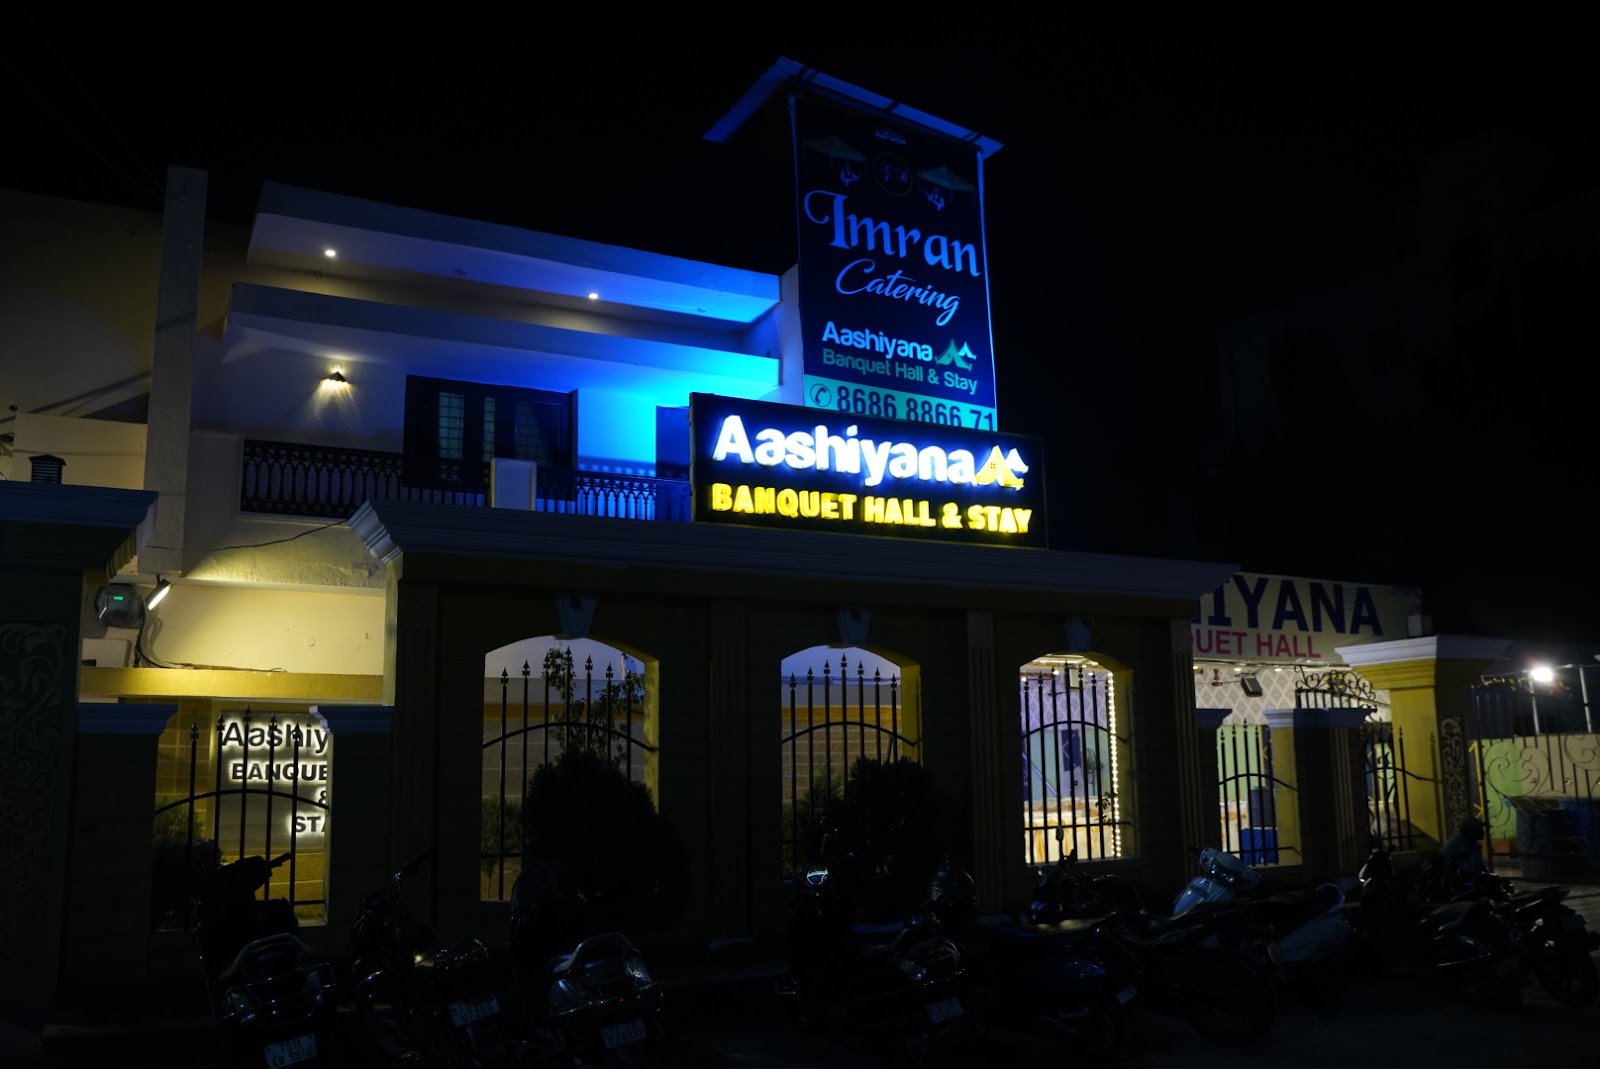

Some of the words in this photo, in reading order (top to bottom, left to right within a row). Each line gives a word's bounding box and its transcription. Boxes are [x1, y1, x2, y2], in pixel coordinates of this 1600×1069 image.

[804, 190, 981, 277] Imran
[835, 258, 960, 326] Catering
[822, 321, 933, 361] Aashiyana
[822, 348, 891, 376] Banquet
[895, 361, 924, 382] Hall
[927, 368, 939, 385] &
[944, 371, 978, 395] Stay
[837, 386, 897, 418] 8686
[906, 398, 962, 427] 8866
[969, 409, 993, 431] 71
[712, 415, 977, 487] Aashiyana
[711, 482, 857, 520] BANQUET
[864, 496, 936, 528] HALL
[942, 503, 962, 529] &
[967, 504, 1032, 534] STAY
[1256, 633, 1321, 658] HALL
